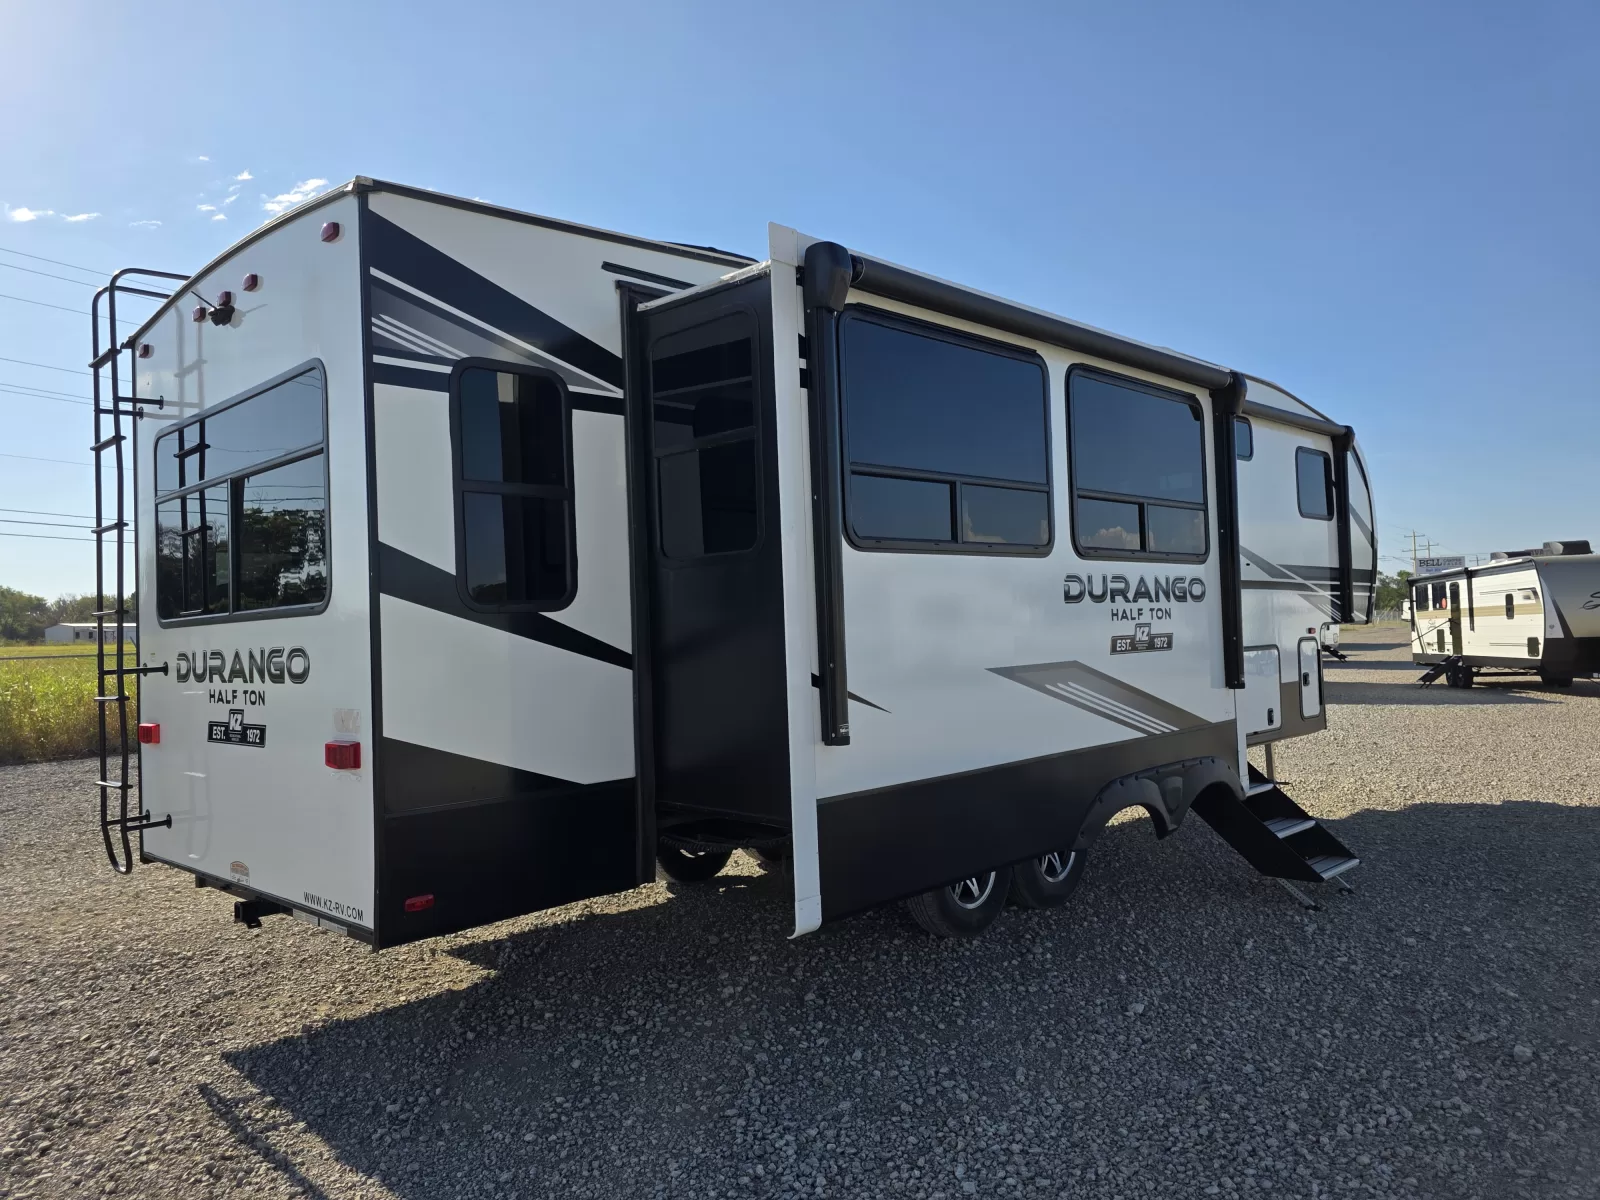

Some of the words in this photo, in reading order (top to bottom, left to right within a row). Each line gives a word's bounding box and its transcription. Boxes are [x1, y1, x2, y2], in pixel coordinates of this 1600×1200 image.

[1419, 559, 1442, 567] BELL
[1064, 573, 1206, 604] DURANGO
[1111, 608, 1144, 621] HALF
[1149, 608, 1172, 620] TON
[1136, 627, 1149, 641] KZ
[1116, 639, 1131, 651] EST.
[1154, 637, 1168, 648] 1972
[176, 646, 310, 684] DURANGO
[209, 689, 238, 704] HALF
[243, 690, 266, 706] TON
[230, 713, 242, 730] KZ
[212, 726, 226, 739] EST.
[246, 728, 260, 743] 1972
[303, 891, 364, 922] WWW.KZ-RV.COM
